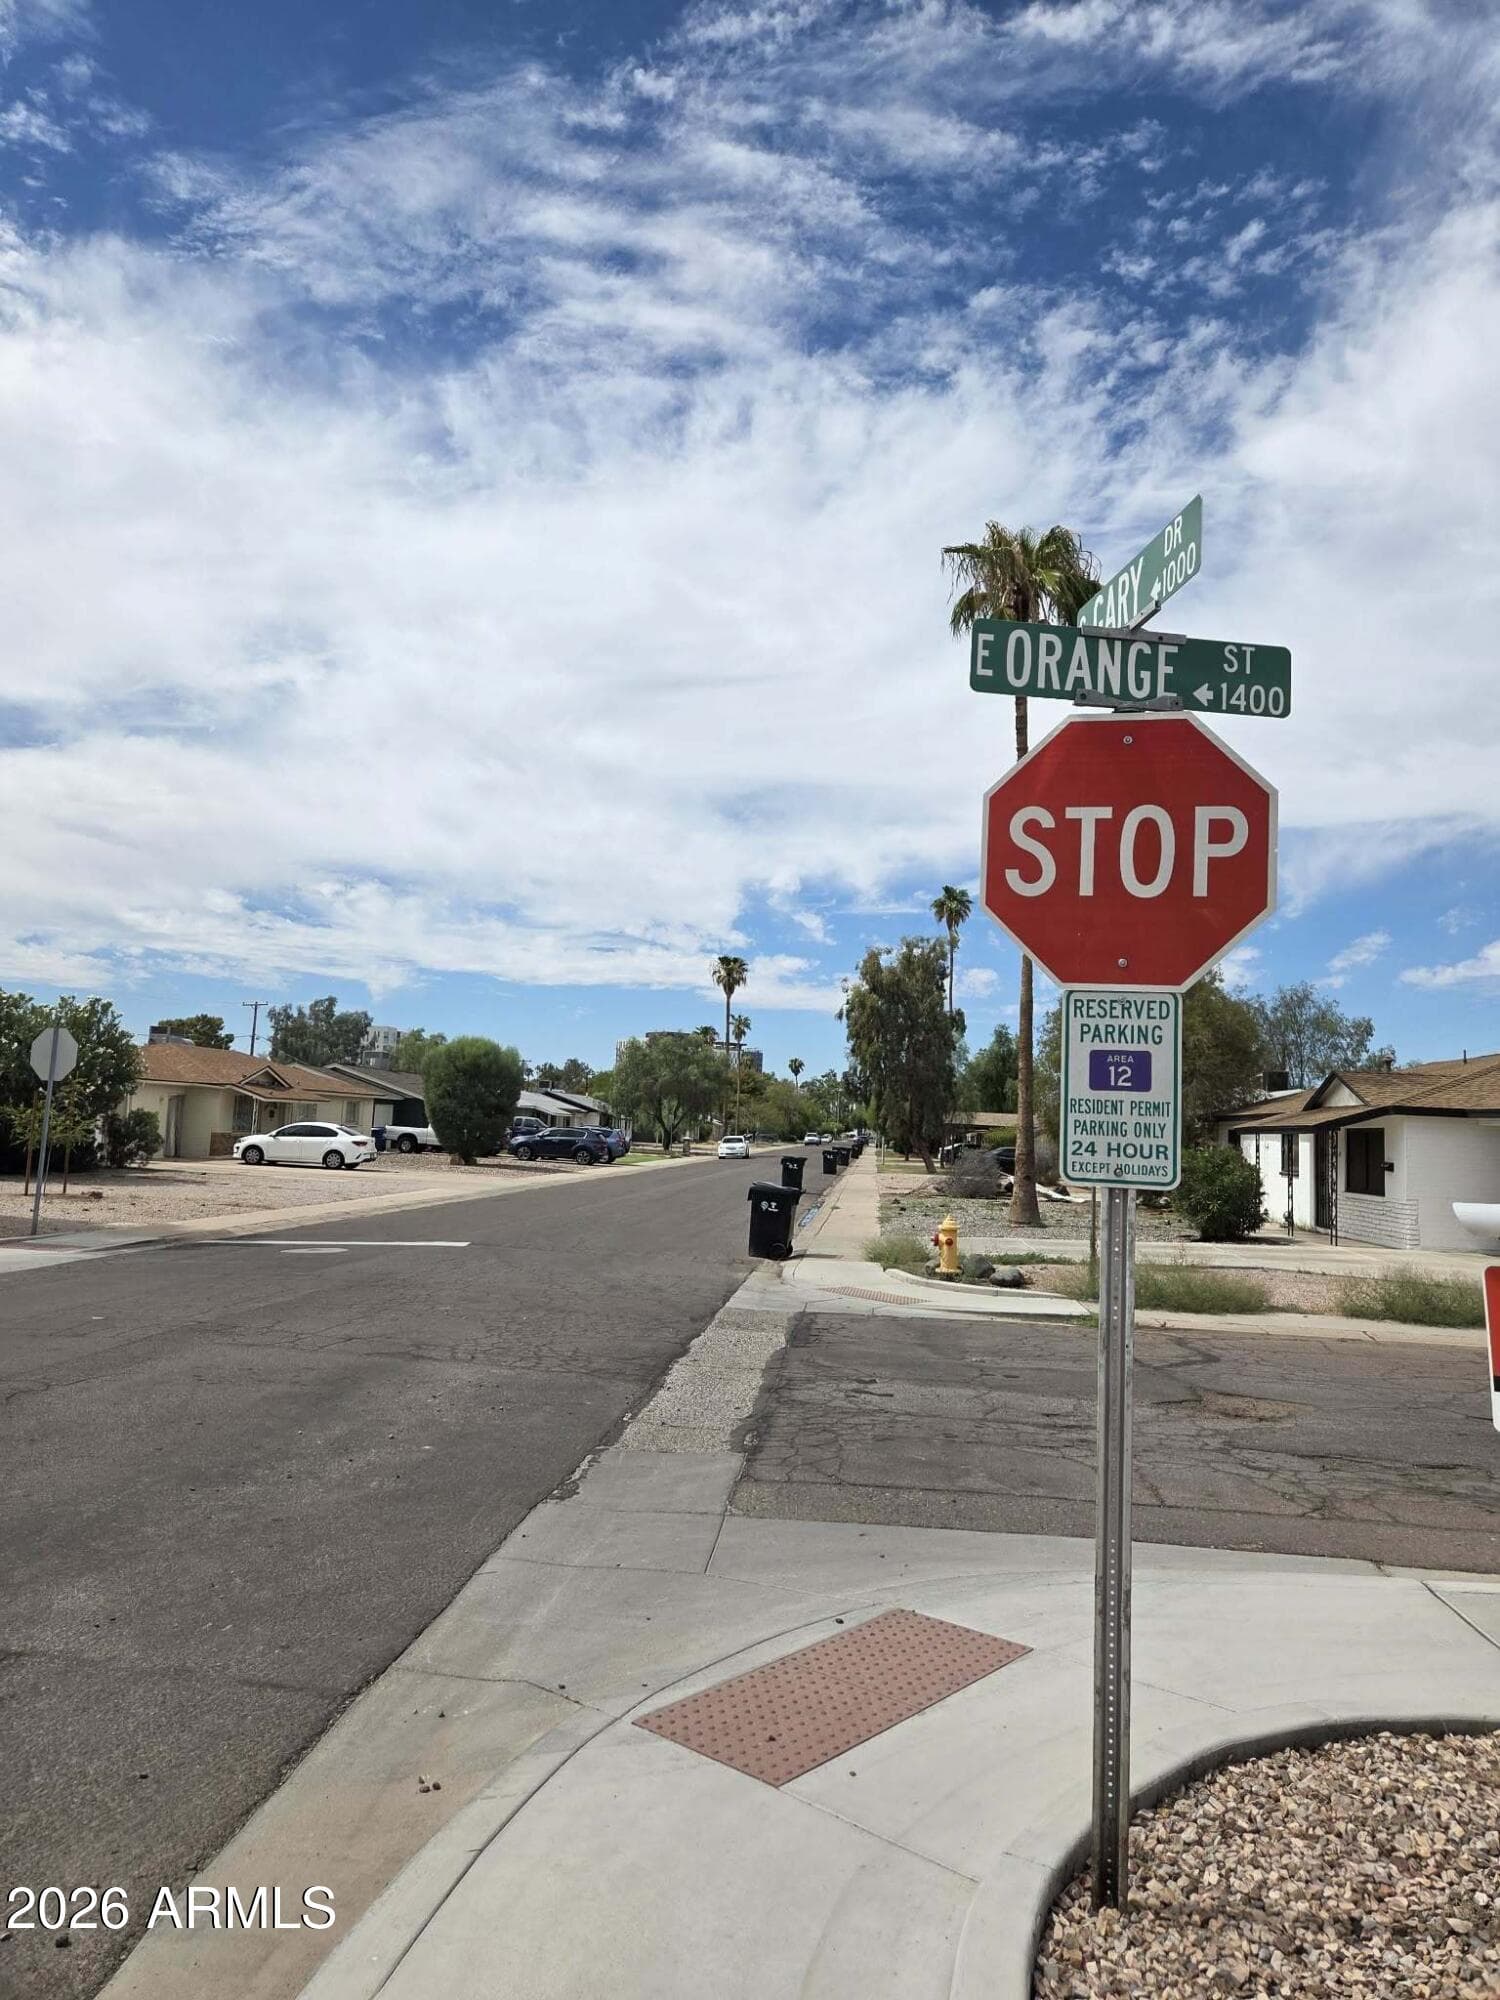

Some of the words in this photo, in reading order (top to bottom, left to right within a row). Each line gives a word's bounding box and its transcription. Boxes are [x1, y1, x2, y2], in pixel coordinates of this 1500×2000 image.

[1093, 556, 1144, 628] CARY
[1164, 515, 1183, 557] DR
[1162, 542, 1196, 597] 1000
[976, 633, 995, 677] E
[1006, 629, 1179, 699] ORANGE
[1223, 645, 1256, 675] ST
[1220, 683, 1284, 715] 1400
[1005, 804, 1249, 898] STOP
[1073, 999, 1170, 1020] RESERVED
[1080, 1023, 1163, 1045] PARKING
[1106, 1055, 1134, 1063] AREA
[1108, 1066, 1132, 1087] 12
[1070, 1098, 1124, 1116] RESIDENT
[1130, 1101, 1171, 1118] PERMIT
[1073, 1119, 1128, 1138] PARKING
[1134, 1122, 1166, 1139] ONLY
[1071, 1140, 1097, 1157] 24
[1107, 1142, 1169, 1160] HOUR
[1071, 1161, 1111, 1174] EXCEPT
